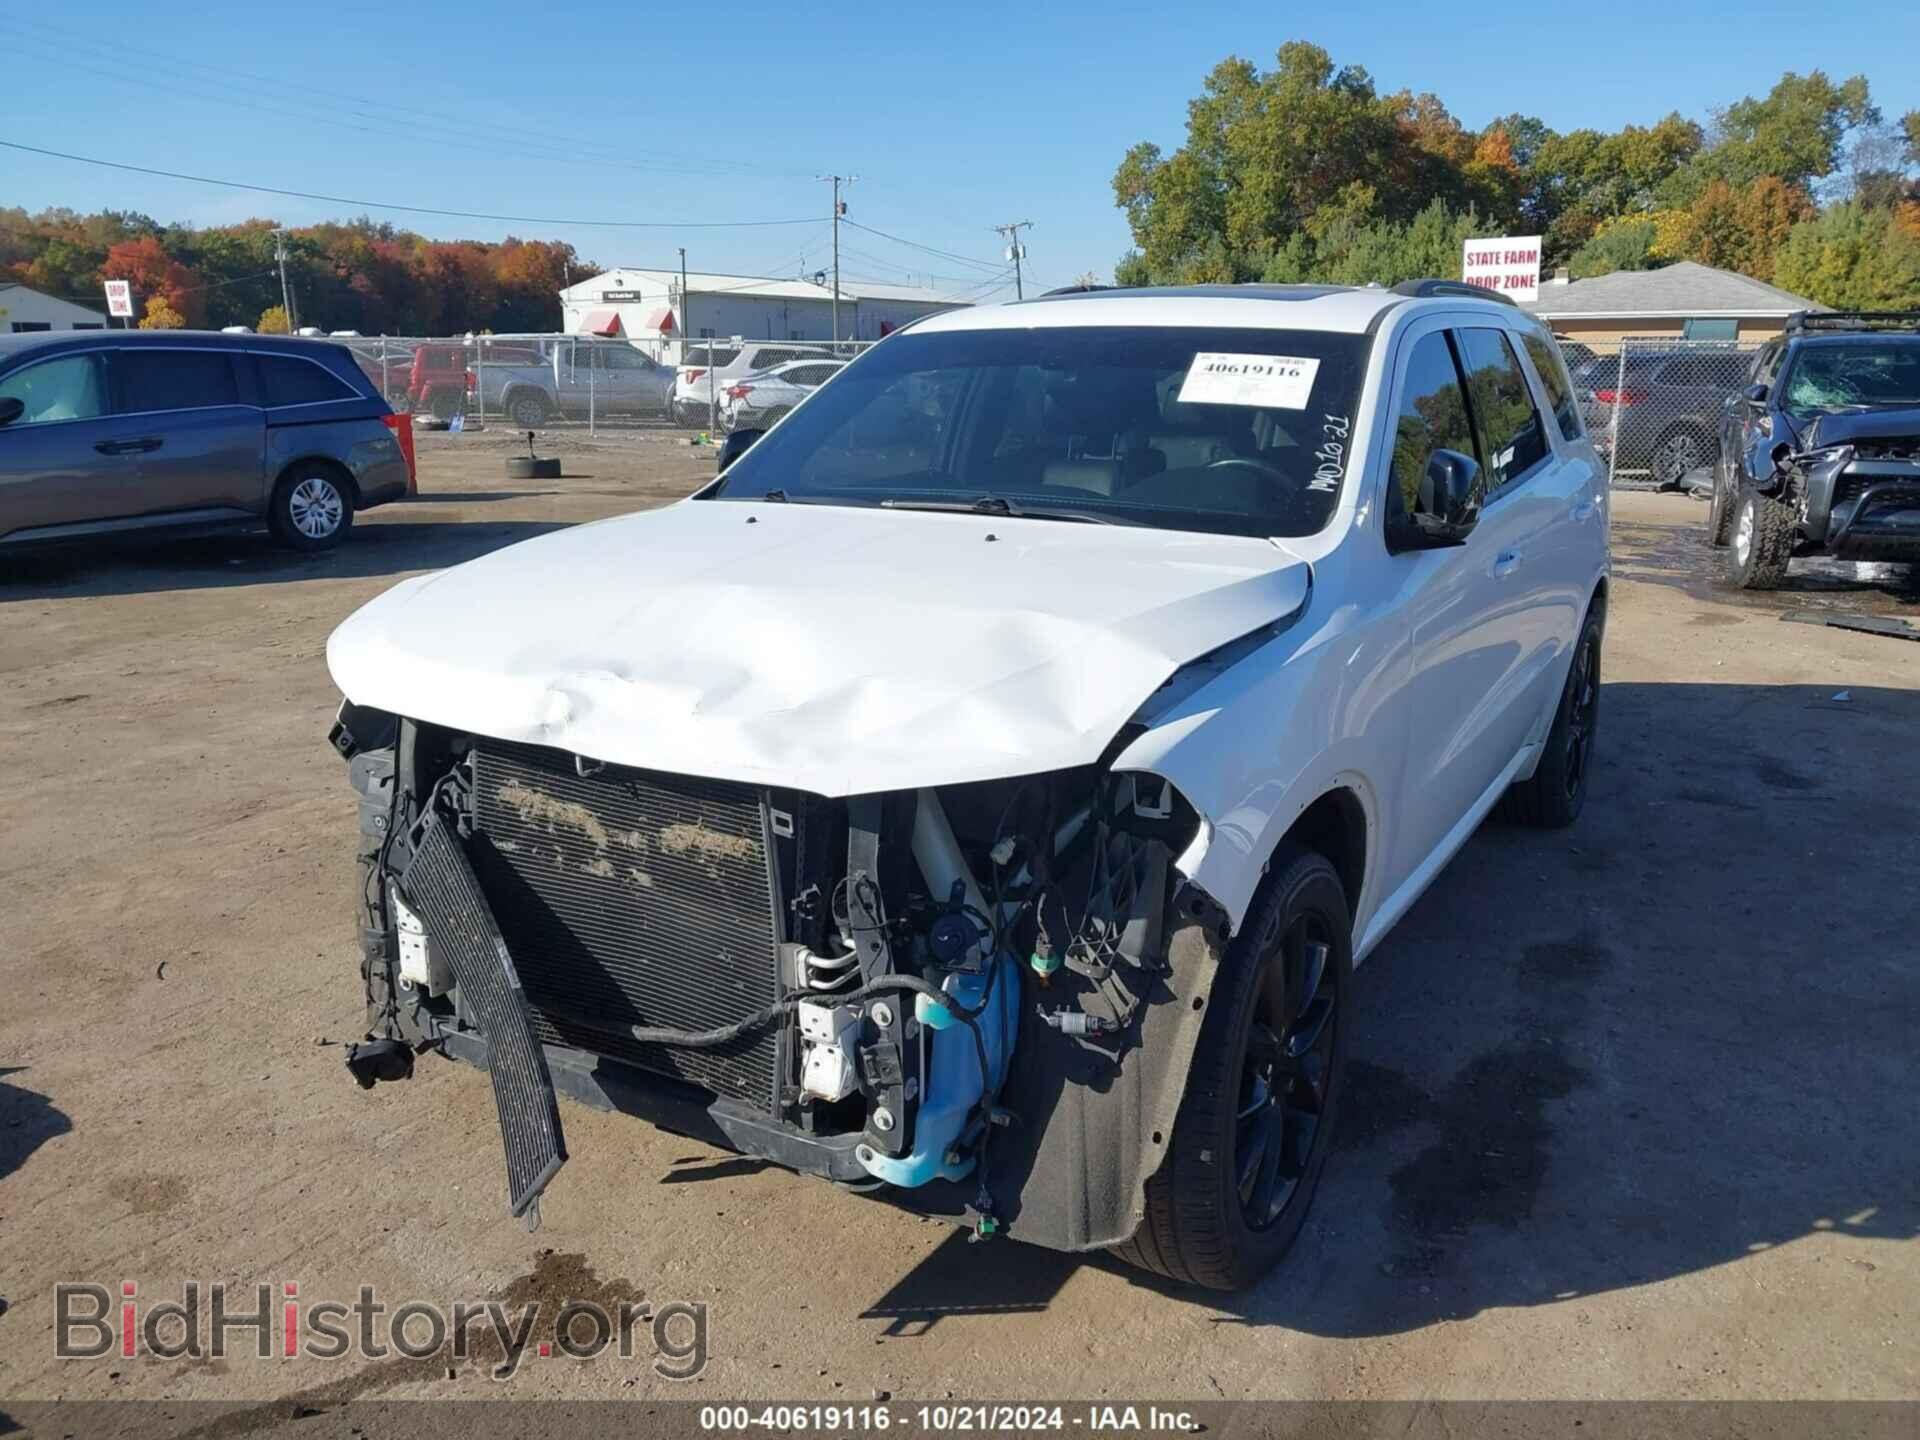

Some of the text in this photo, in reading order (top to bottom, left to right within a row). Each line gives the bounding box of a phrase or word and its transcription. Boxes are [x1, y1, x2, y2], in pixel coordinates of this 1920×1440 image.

[1467, 250, 1537, 266] STATE FARM
[1504, 274, 1536, 289] ZONE
[1203, 362, 1300, 376] 40619116
